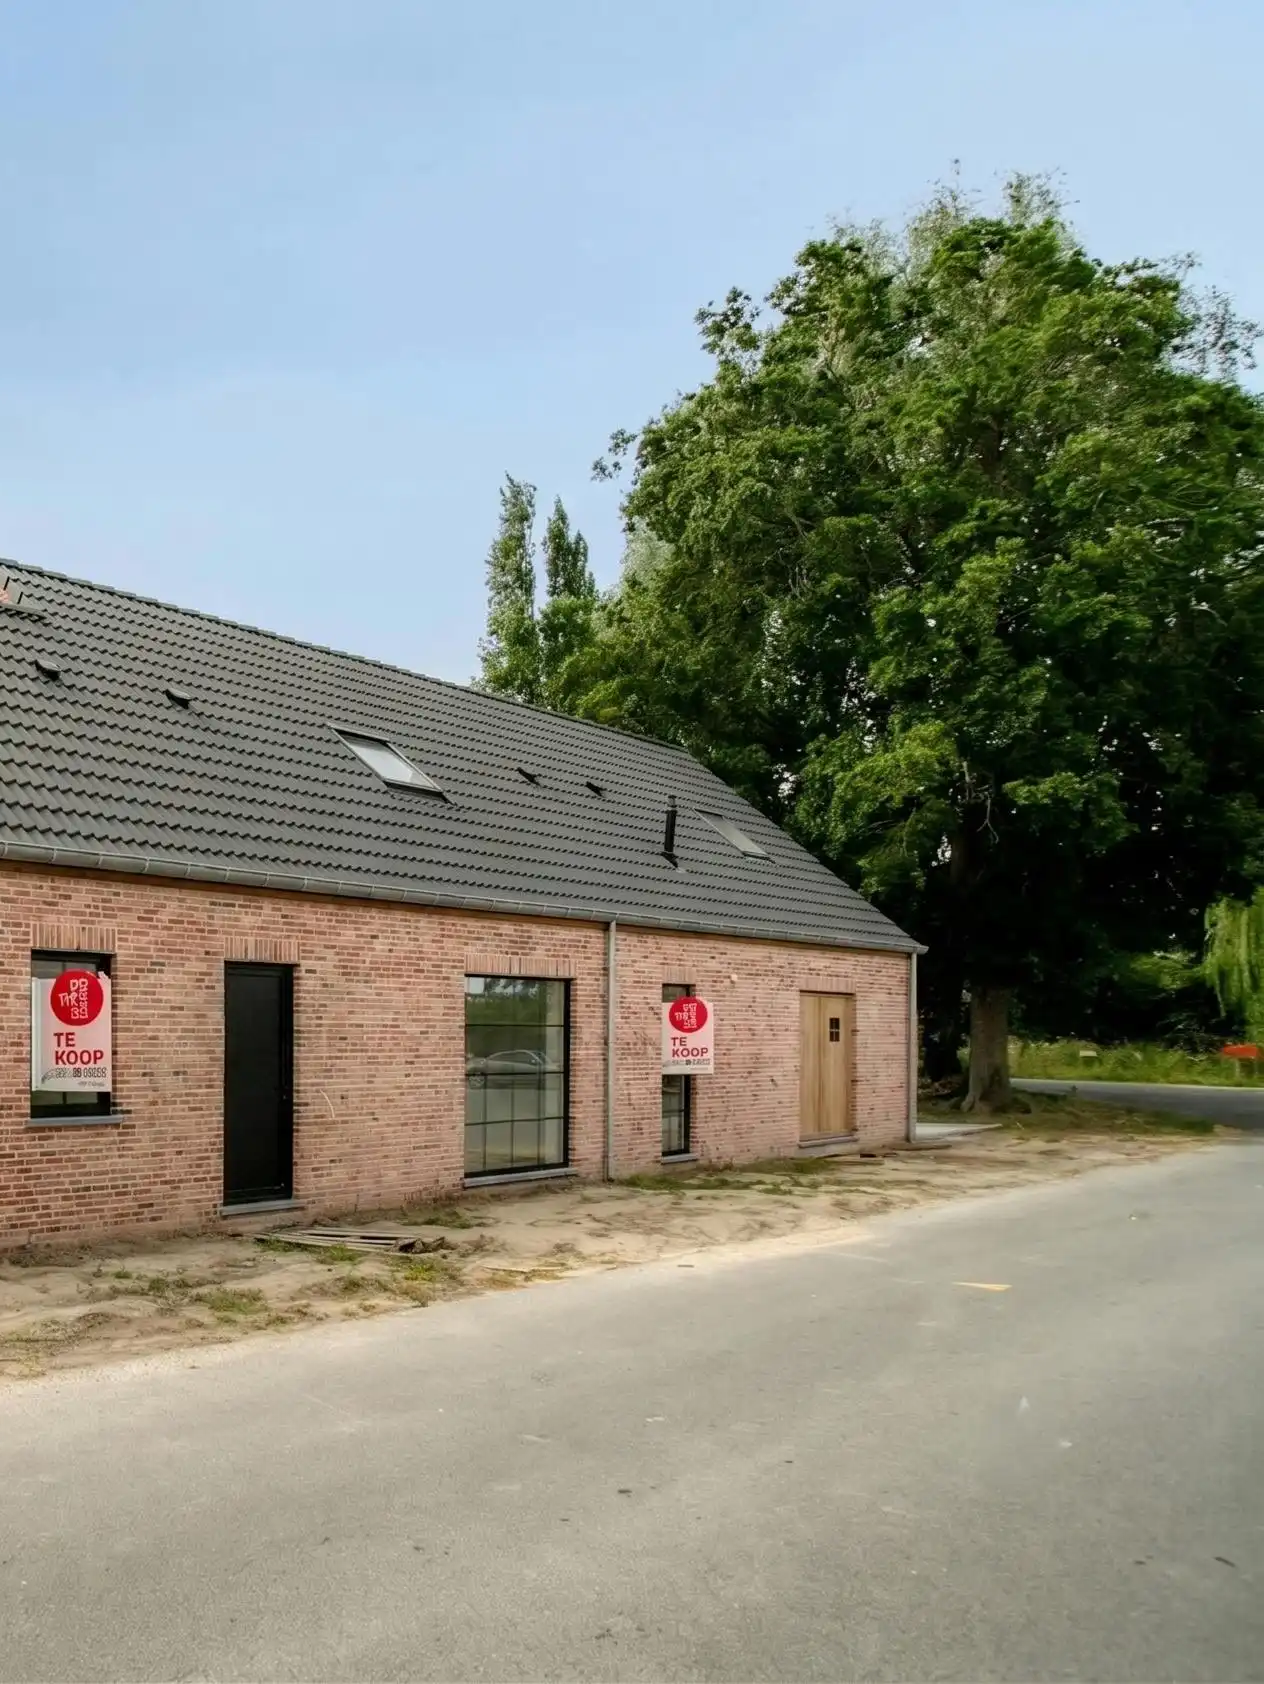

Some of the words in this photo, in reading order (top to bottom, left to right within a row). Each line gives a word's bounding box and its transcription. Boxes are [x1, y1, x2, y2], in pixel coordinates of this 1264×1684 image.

[53, 1032, 75, 1047] TE
[671, 1037, 687, 1046] TE
[55, 1050, 104, 1065] KOOP
[672, 1048, 708, 1057] KOOP
